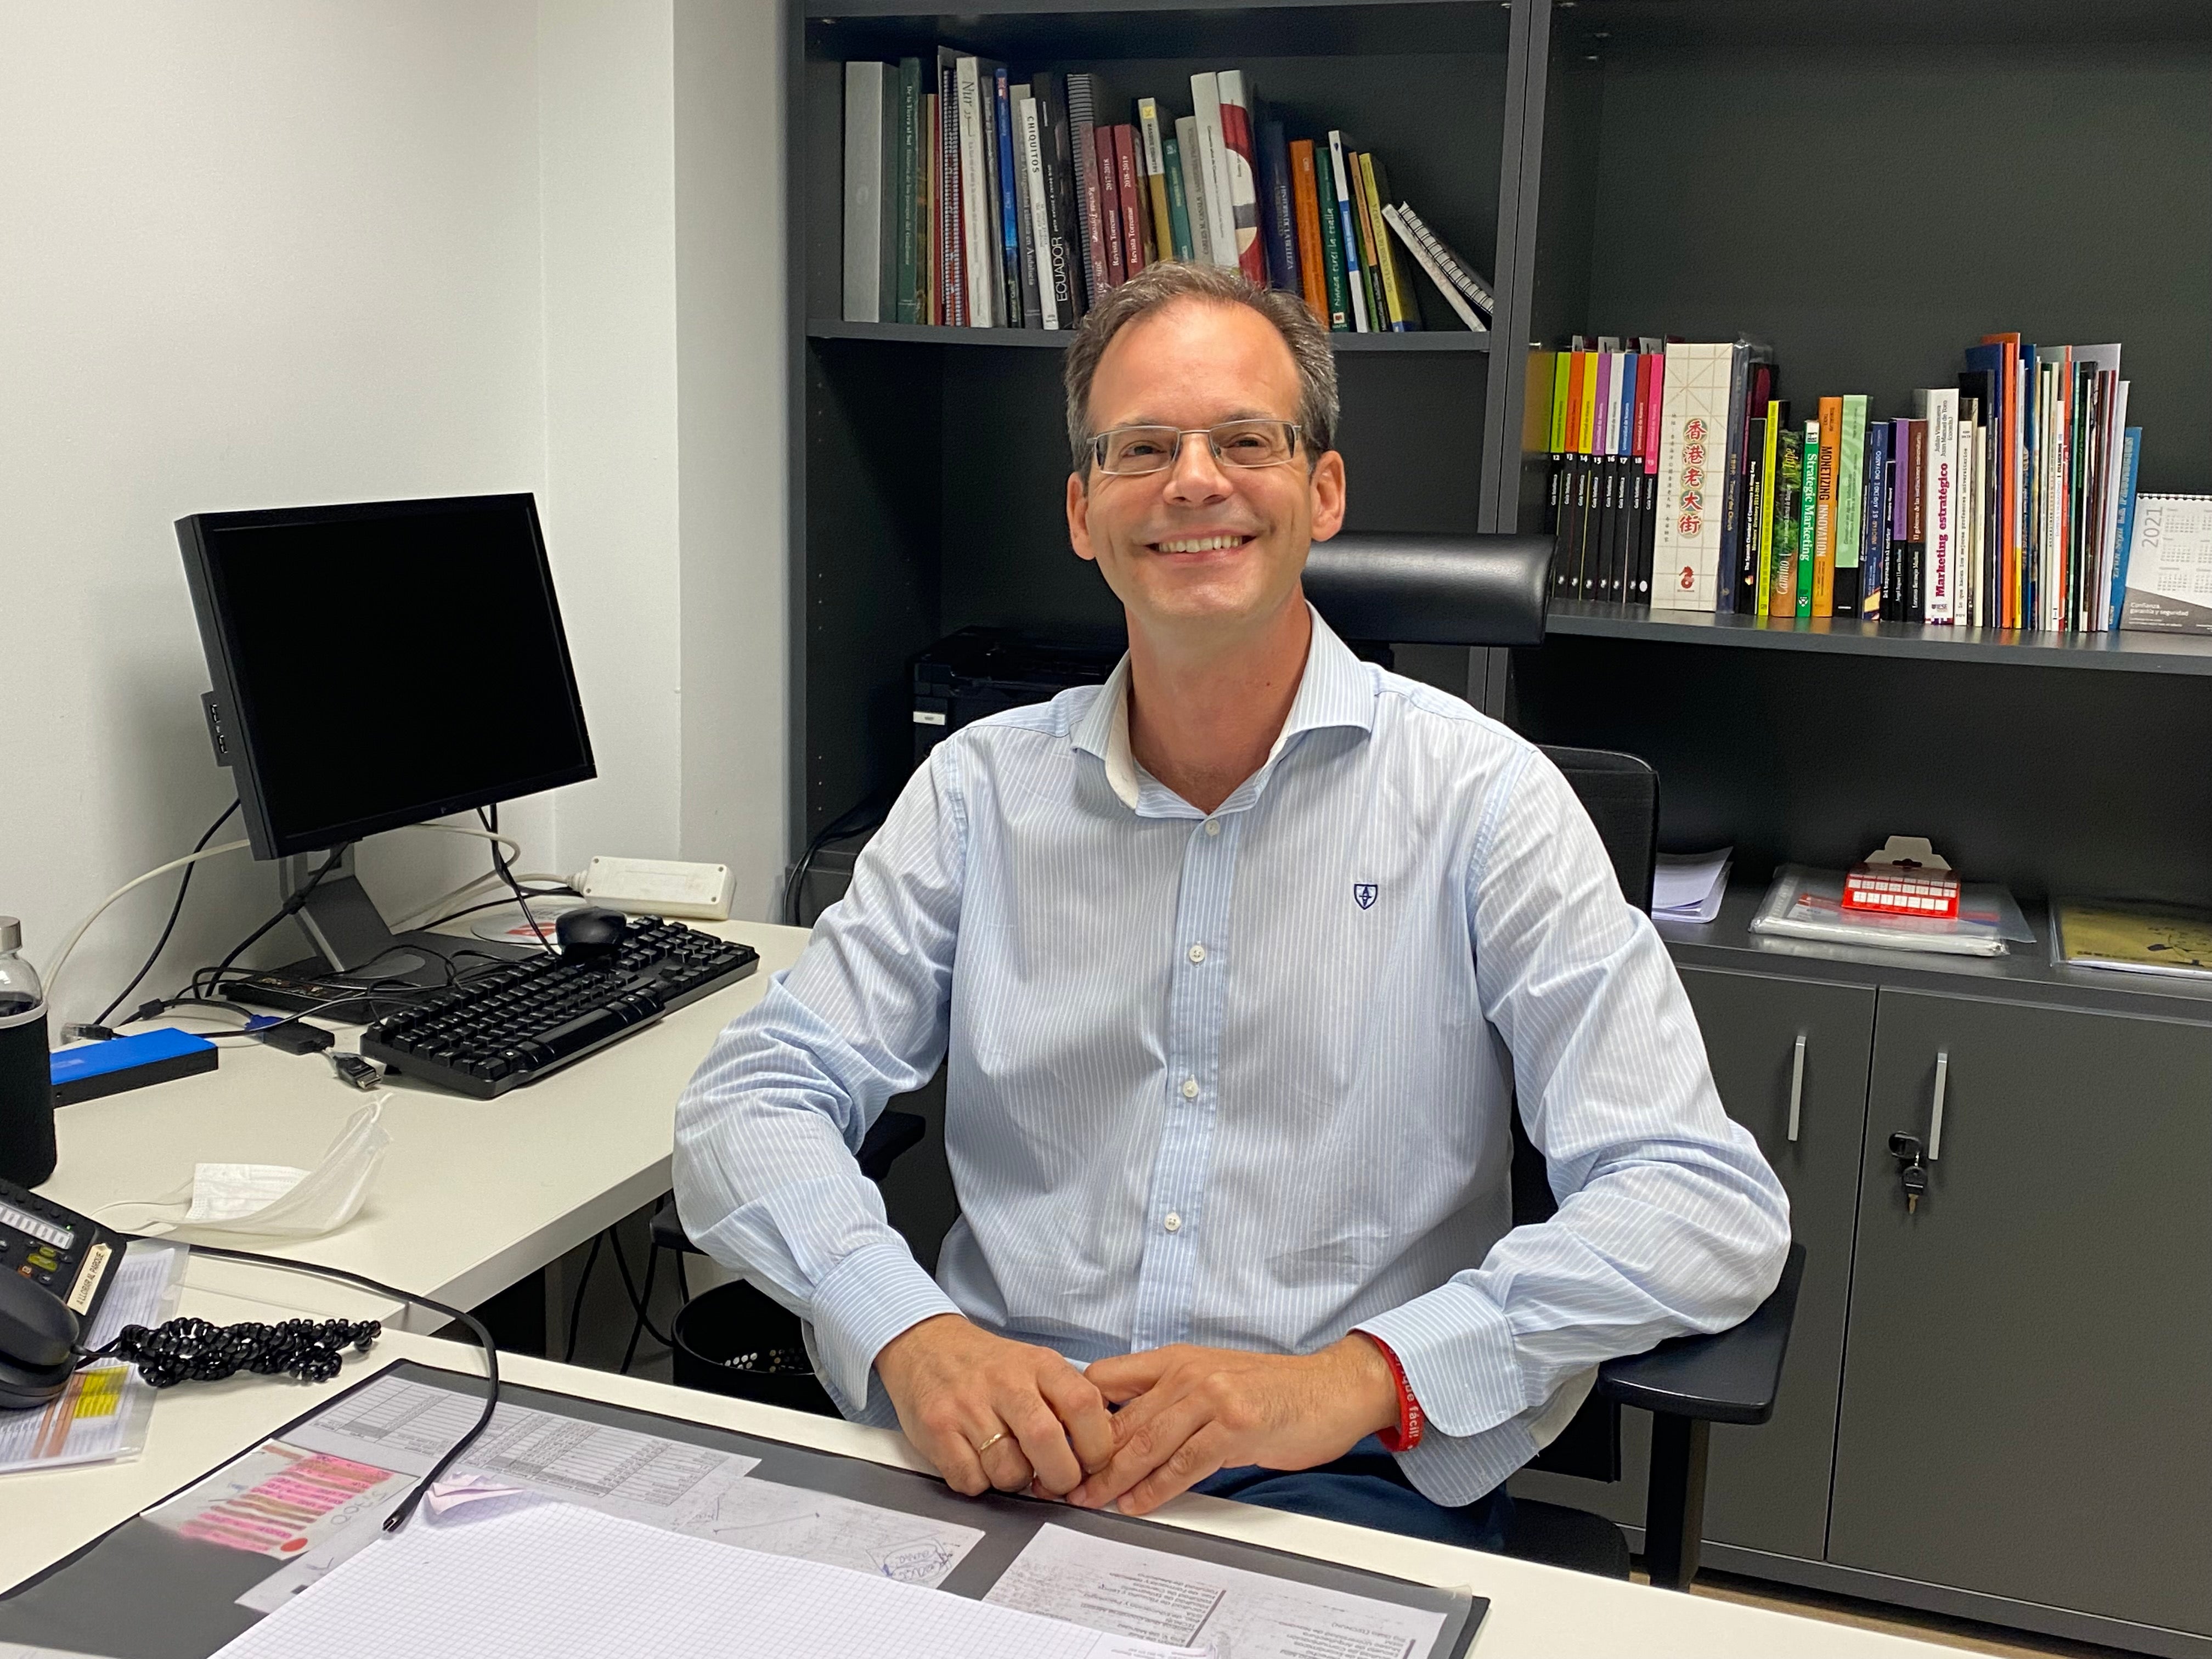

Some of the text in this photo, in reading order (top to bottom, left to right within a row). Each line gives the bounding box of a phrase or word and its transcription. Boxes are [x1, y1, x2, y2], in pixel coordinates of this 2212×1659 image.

[962, 80, 975, 106] Nur
[1027, 116, 1040, 174] CHIQUITOS
[1109, 210, 1117, 240] Torremar
[1122, 156, 1138, 263] Revista Torremar 2018-2019
[1052, 236, 1068, 302] ECUADOR
[1328, 239, 1336, 247] la
[1679, 419, 1707, 535] 香港老大街
[1819, 445, 1832, 501] MONETIZING
[1936, 462, 1950, 530] estratégico
[1800, 453, 1817, 561] Strategic Marketing
[1816, 505, 1830, 557] INNOVATION
[2142, 506, 2163, 548] 2021
[1776, 561, 1789, 595] Camino
[1935, 533, 1948, 597] Marketing
[89, 1251, 105, 1274] PARQUE
[1408, 1405, 1420, 1438] fácil!
